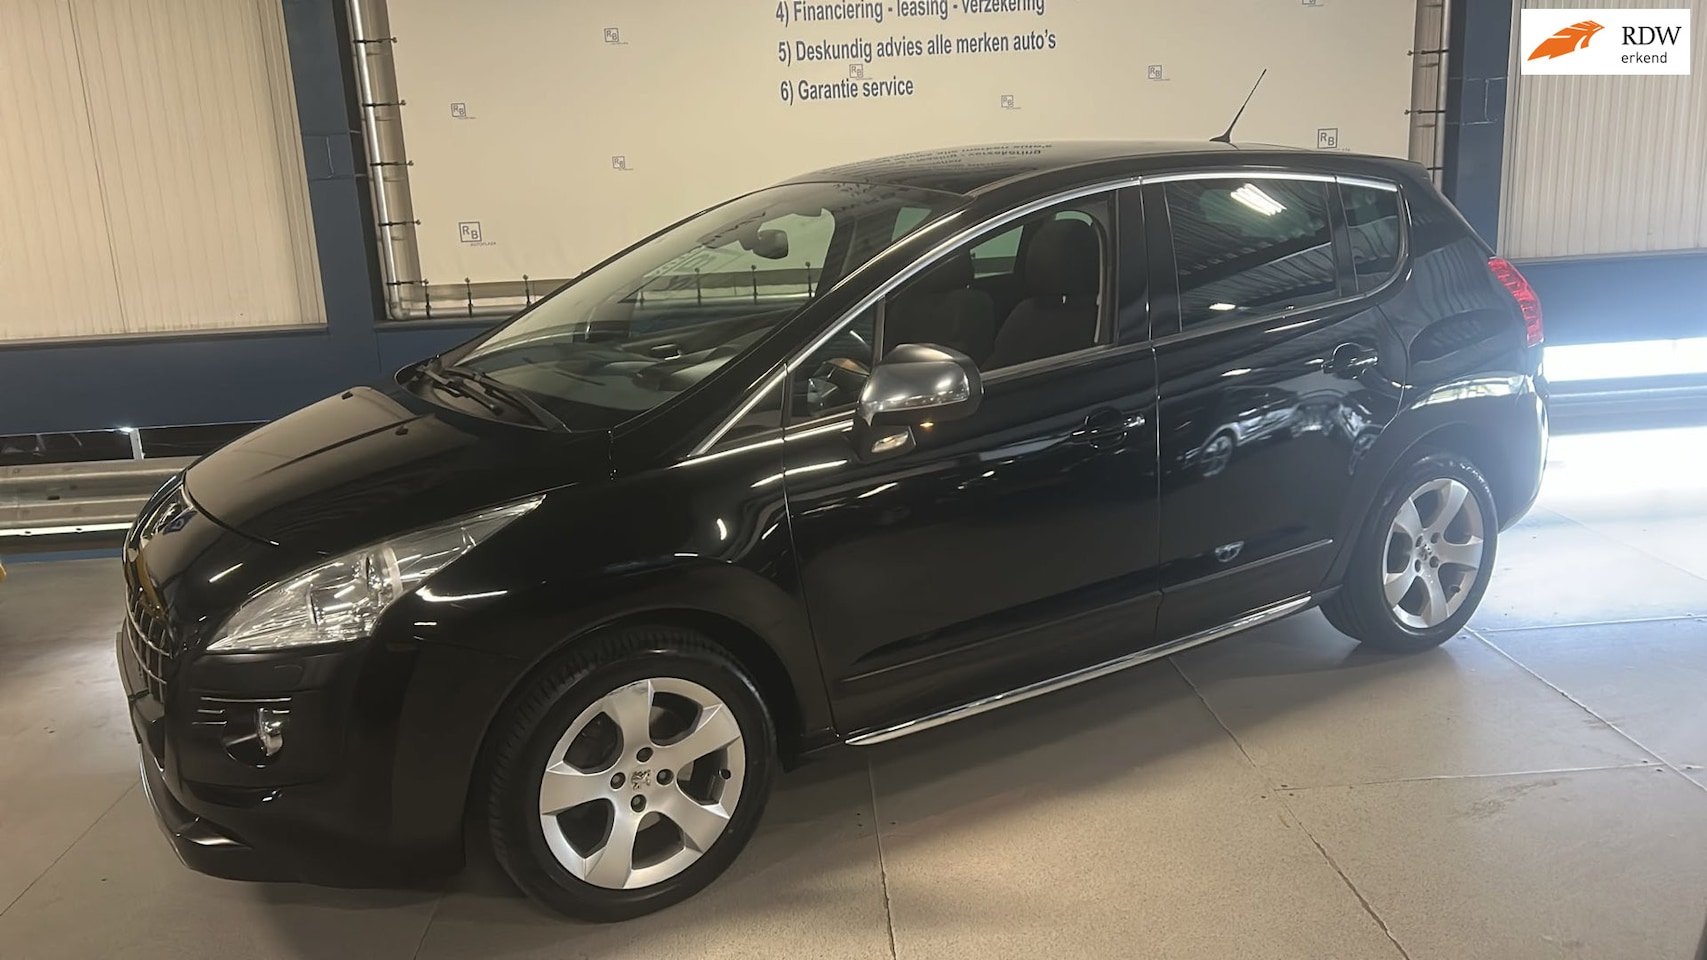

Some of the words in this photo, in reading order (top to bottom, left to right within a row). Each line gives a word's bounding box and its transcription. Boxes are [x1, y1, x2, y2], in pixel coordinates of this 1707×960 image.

[776, 1, 790, 28] 4)
[793, 0, 883, 24] Financiering
[896, 0, 948, 21] leasing
[961, 0, 1045, 16] verzekering
[778, 40, 792, 67] 5)
[796, 38, 872, 63] Deskundig
[876, 36, 923, 57] advies
[927, 33, 952, 55] alle
[956, 32, 1009, 53] merken
[1013, 29, 1056, 50] auto's
[780, 79, 793, 106] 6)
[798, 78, 859, 101] Garantie
[862, 75, 914, 97] service
